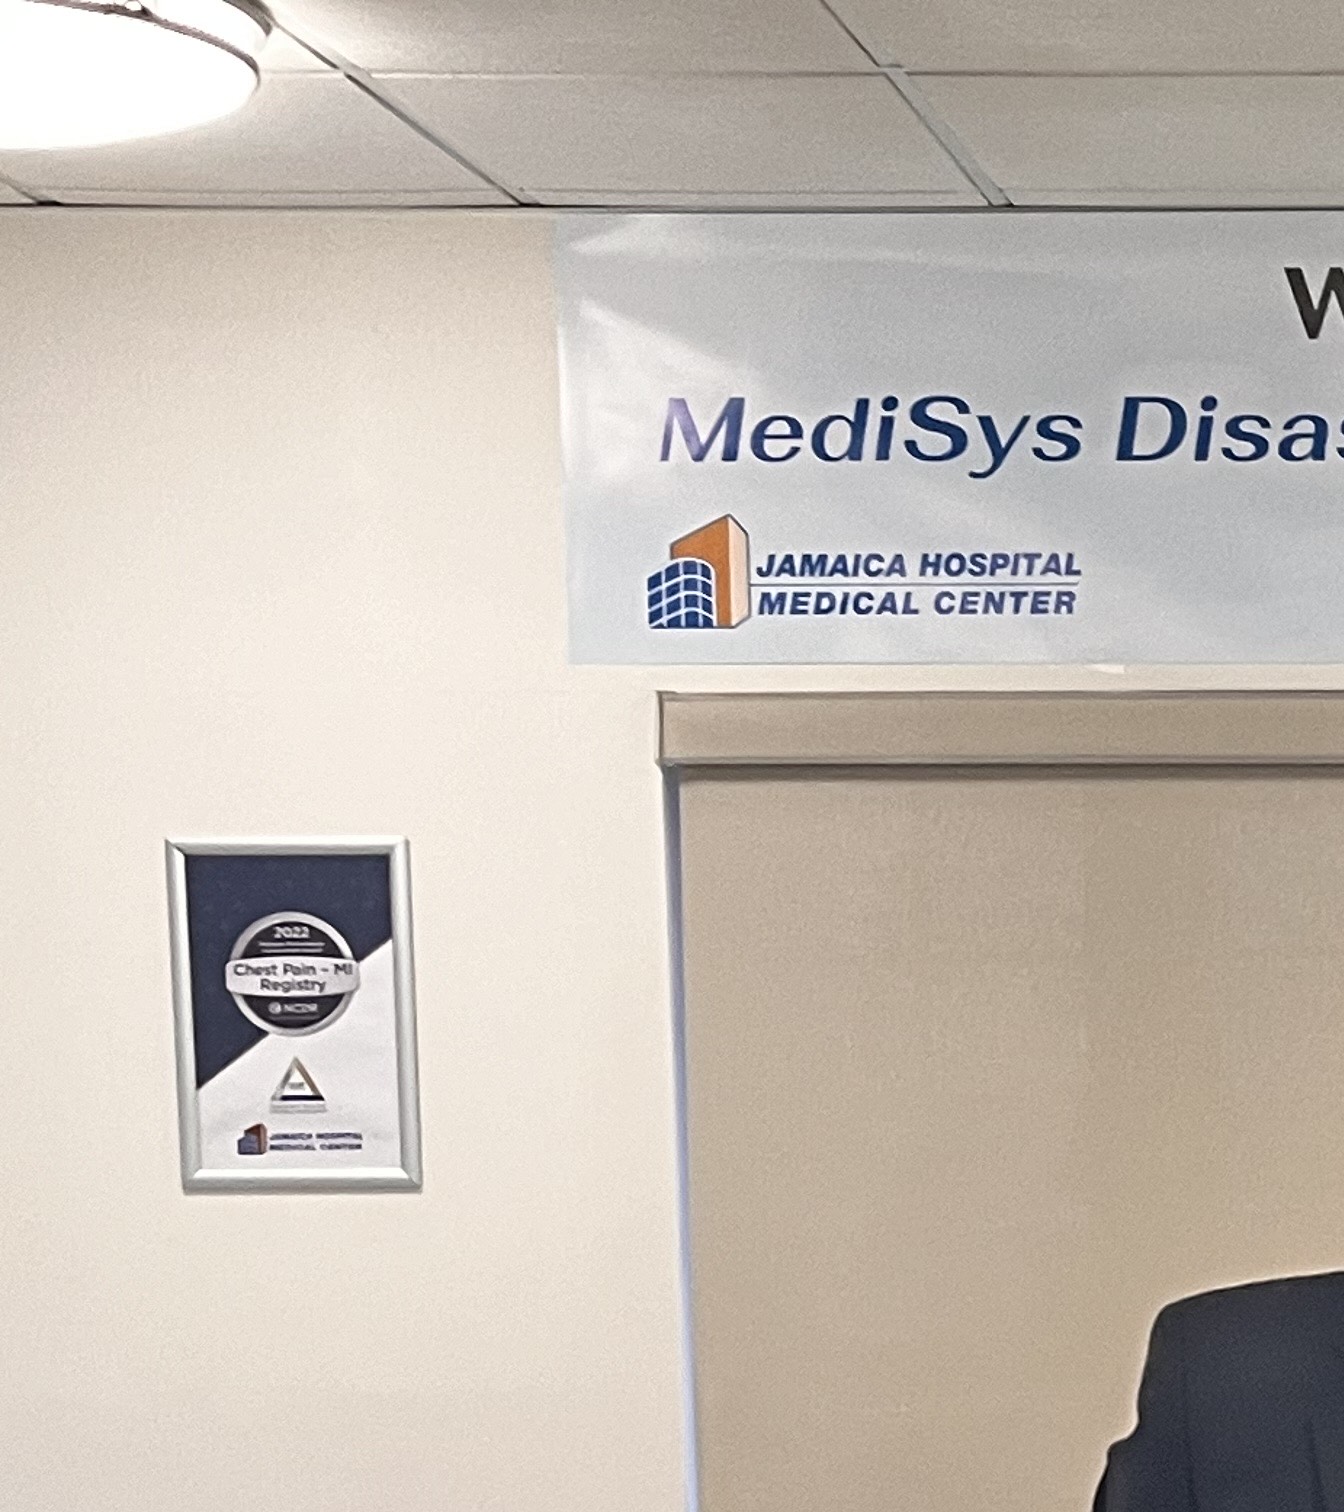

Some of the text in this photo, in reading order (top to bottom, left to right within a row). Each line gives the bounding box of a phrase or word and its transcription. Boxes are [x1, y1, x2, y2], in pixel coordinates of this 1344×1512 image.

[661, 396, 1082, 479] MediSys
[757, 553, 1081, 577] JAMAICA HOSPITAL
[758, 591, 1076, 615] MEDICAL CENTER
[232, 962, 278, 977] Chest
[282, 962, 318, 977] Pain
[333, 963, 353, 976] MI
[259, 977, 328, 994] Registry
